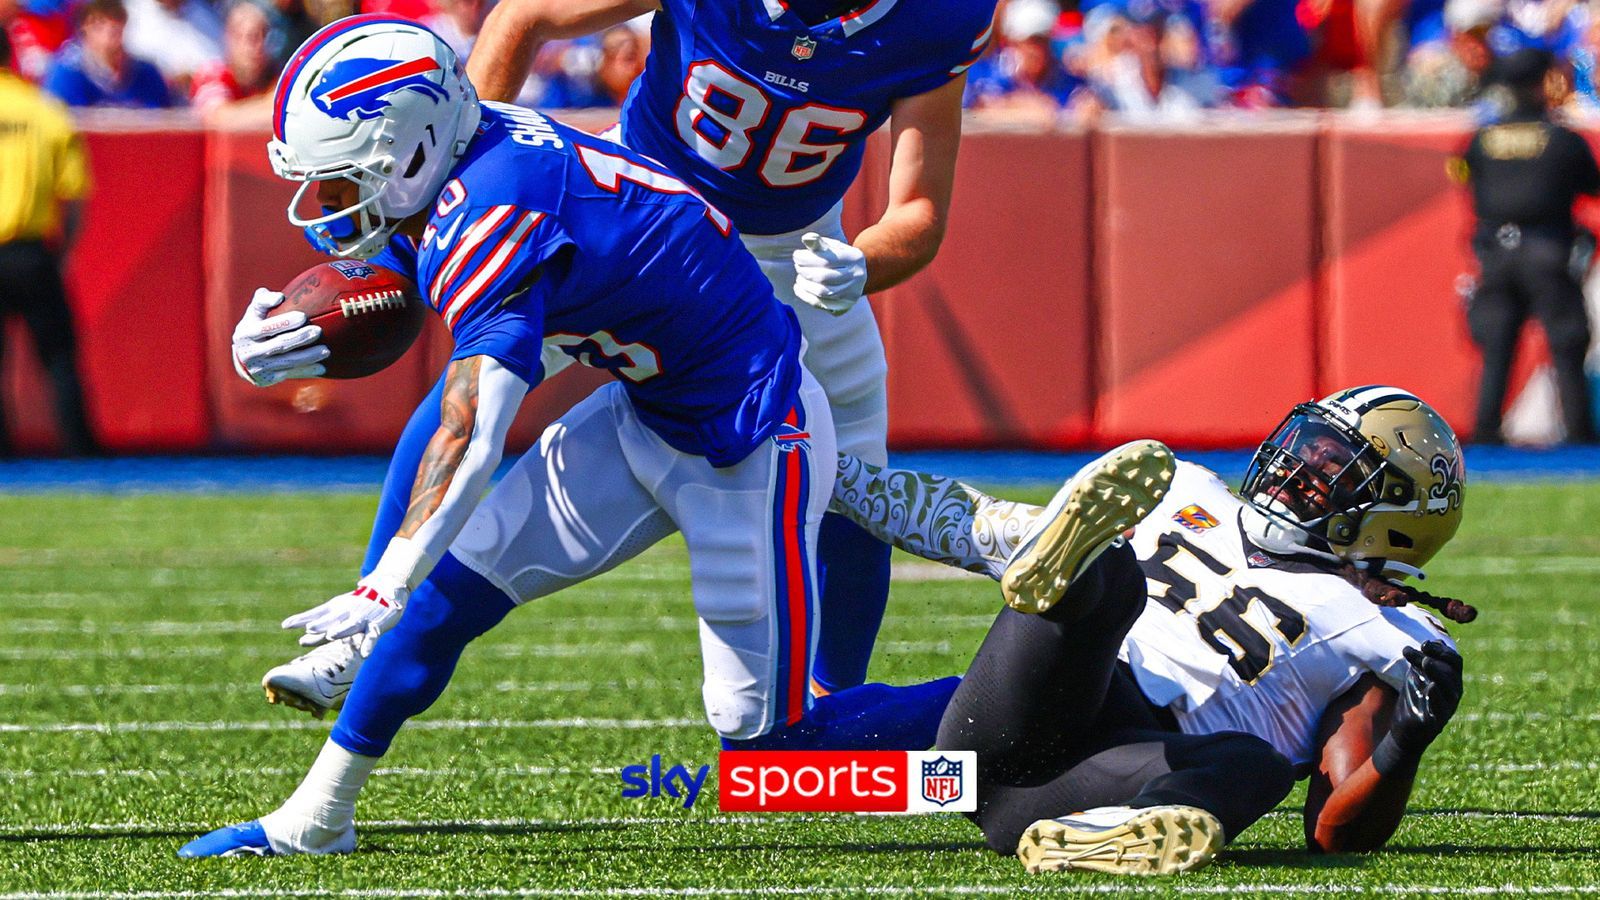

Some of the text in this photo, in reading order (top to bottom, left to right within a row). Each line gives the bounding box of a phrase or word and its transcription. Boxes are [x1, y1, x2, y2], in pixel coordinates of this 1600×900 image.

[672, 58, 868, 188] 86
[764, 71, 809, 92] BILLS
[1136, 531, 1310, 686] 56
